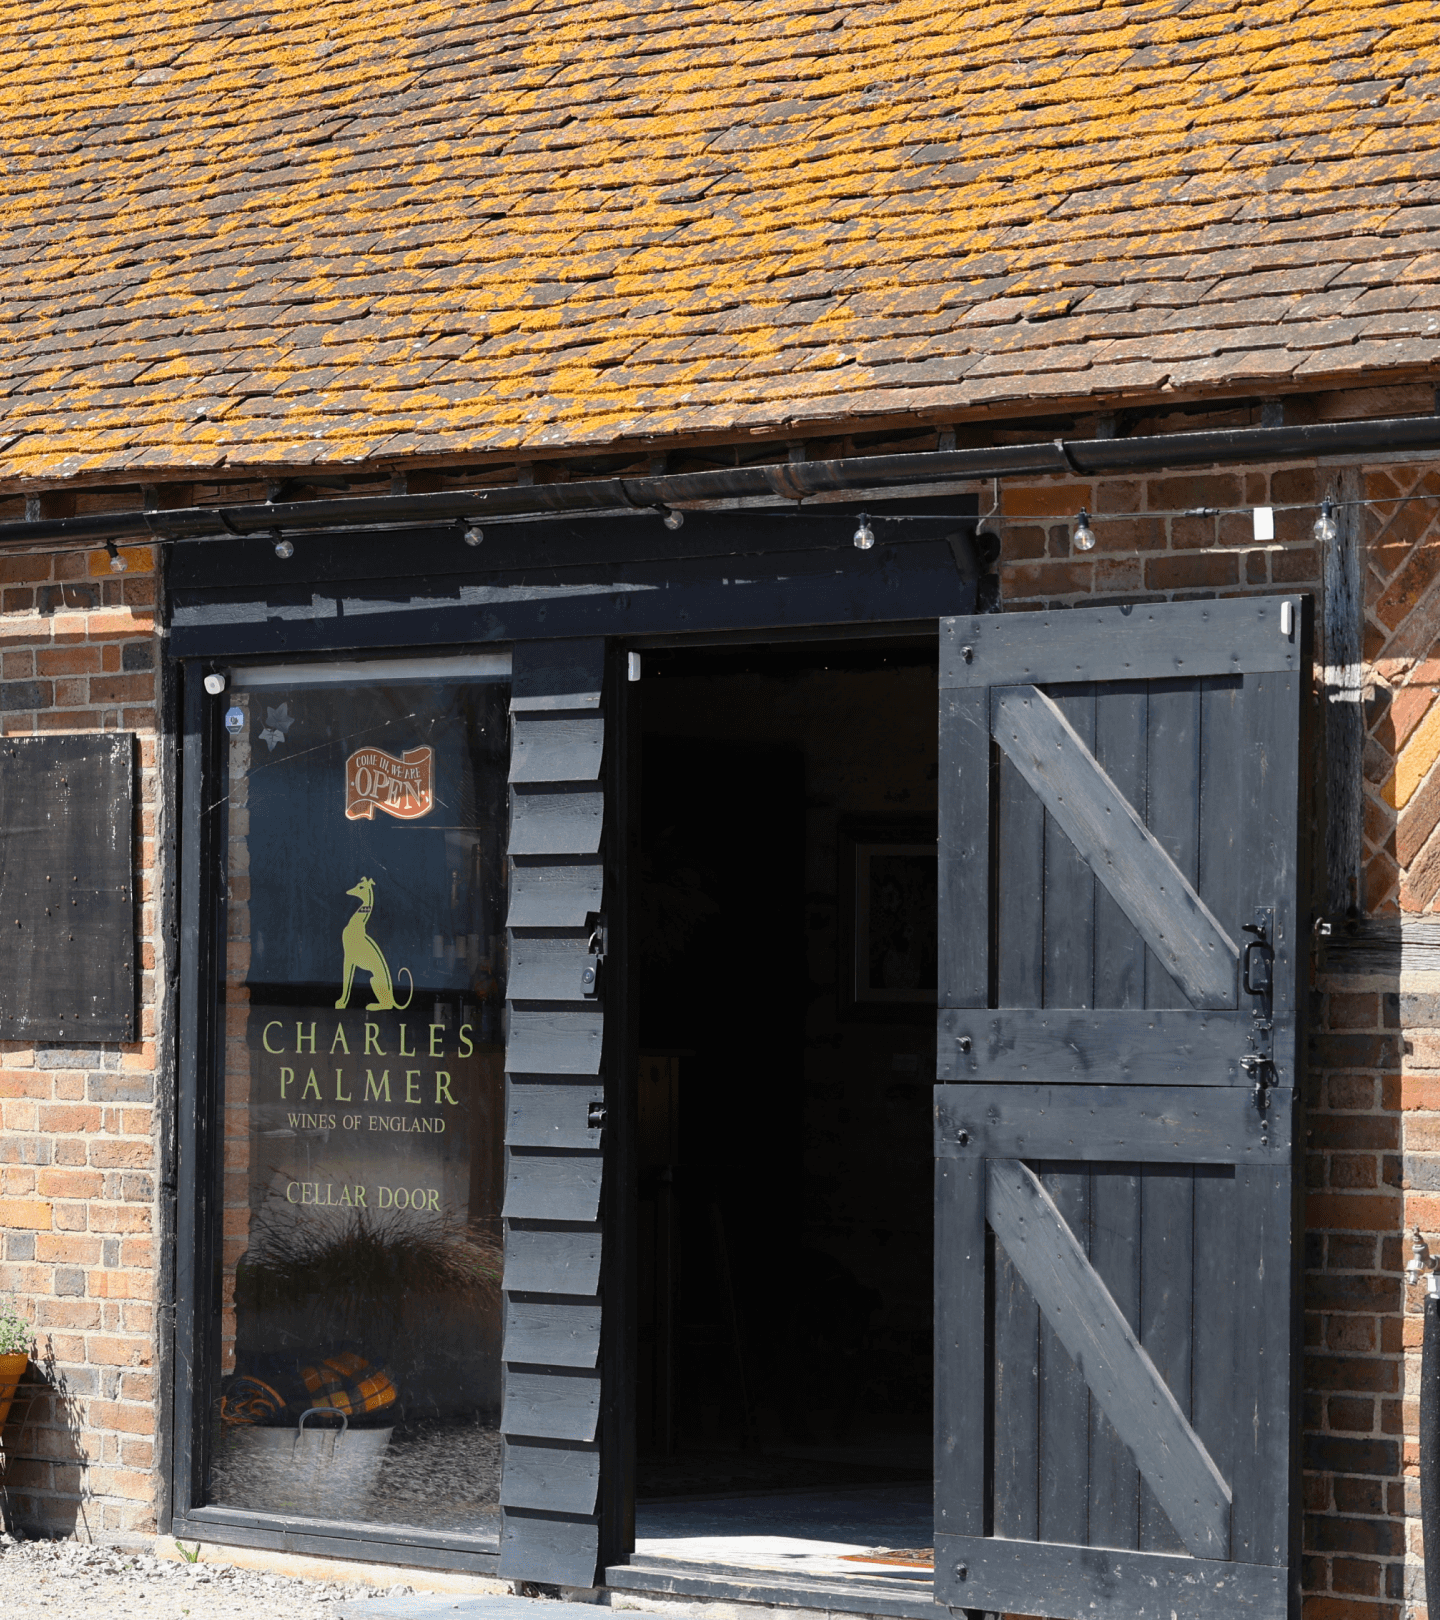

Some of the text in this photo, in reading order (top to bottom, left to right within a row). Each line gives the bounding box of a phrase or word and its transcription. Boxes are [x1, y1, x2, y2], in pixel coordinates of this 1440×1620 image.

[356, 754, 377, 768] COME
[391, 764, 403, 778] WE
[404, 767, 421, 780] ARE
[354, 766, 423, 810] OPEN
[262, 1020, 474, 1059] CHARLES
[279, 1066, 459, 1105] PALMER
[287, 1112, 446, 1133] WINES OF ENGLAND
[286, 1181, 441, 1212] CELLAR DOOR
